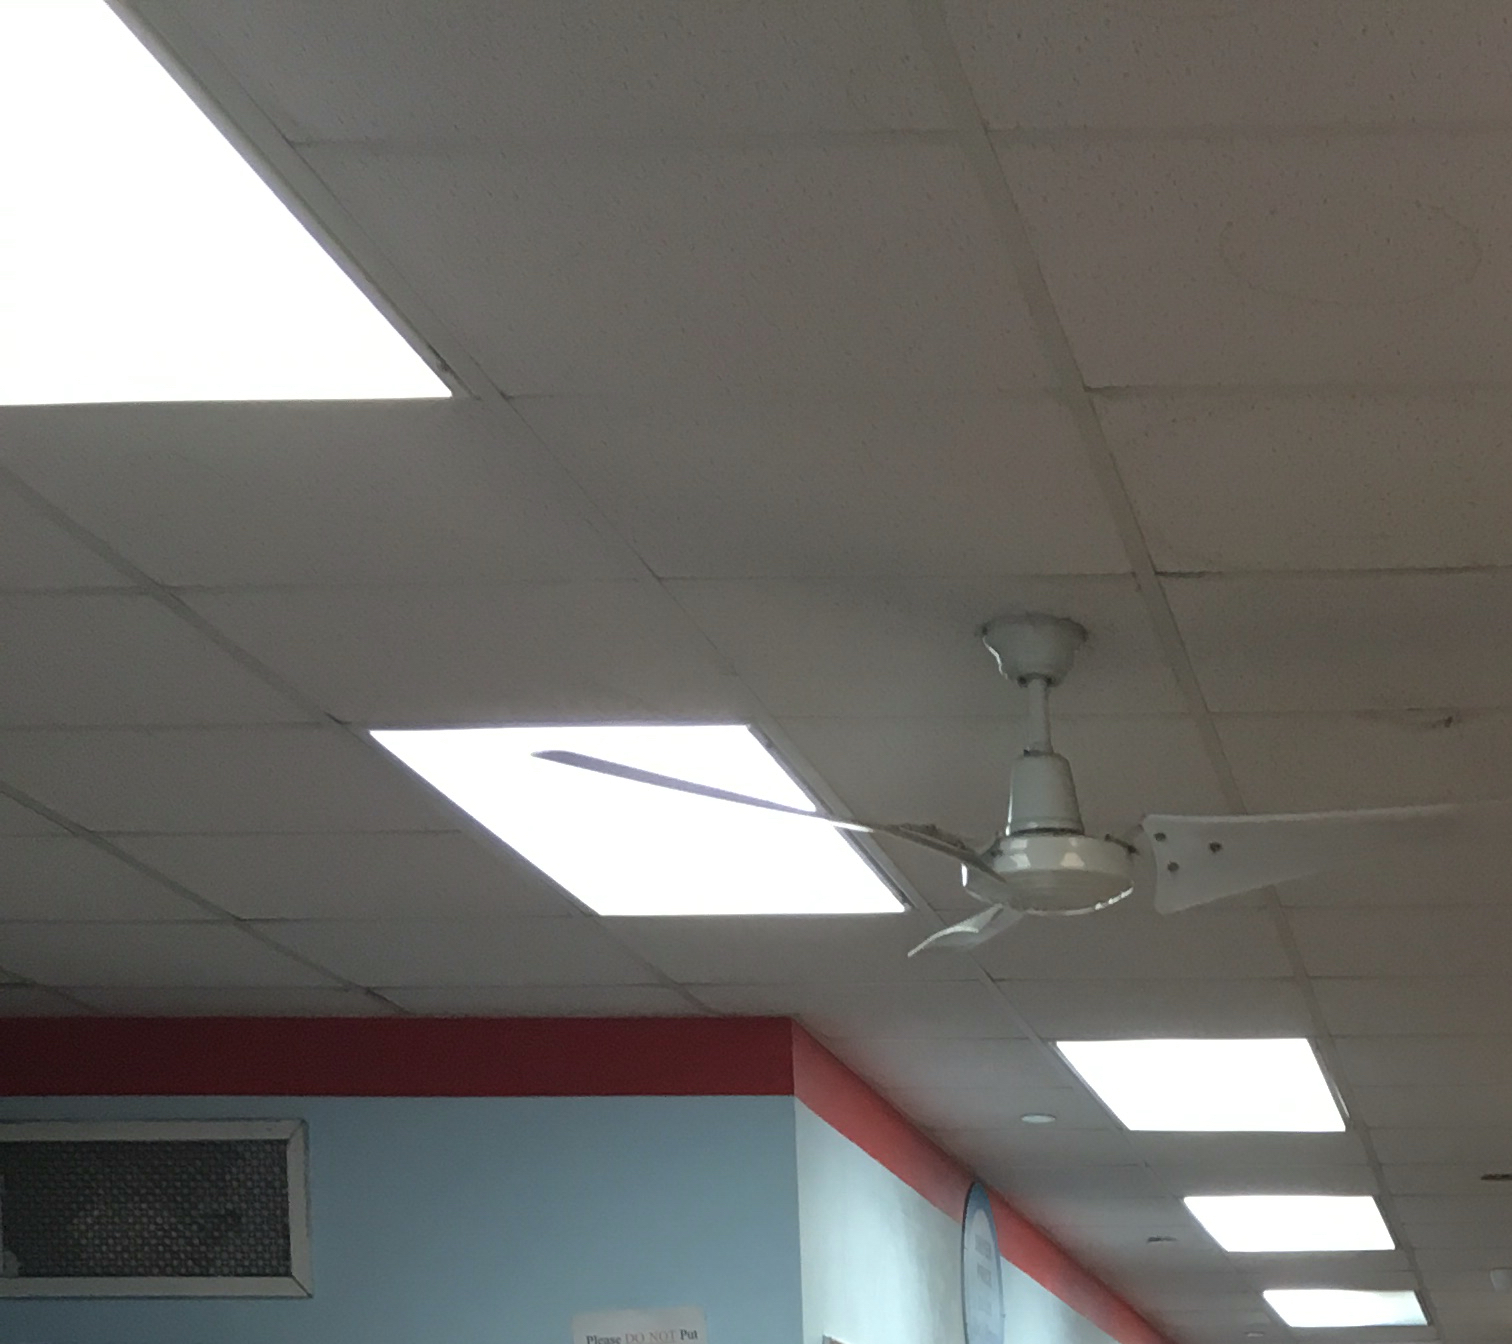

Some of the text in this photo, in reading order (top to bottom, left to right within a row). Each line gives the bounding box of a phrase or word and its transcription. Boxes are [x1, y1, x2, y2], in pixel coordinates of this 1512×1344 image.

[625, 1332, 645, 1344] DO
[649, 1329, 677, 1343] NOT
[679, 1328, 698, 1341] Put
